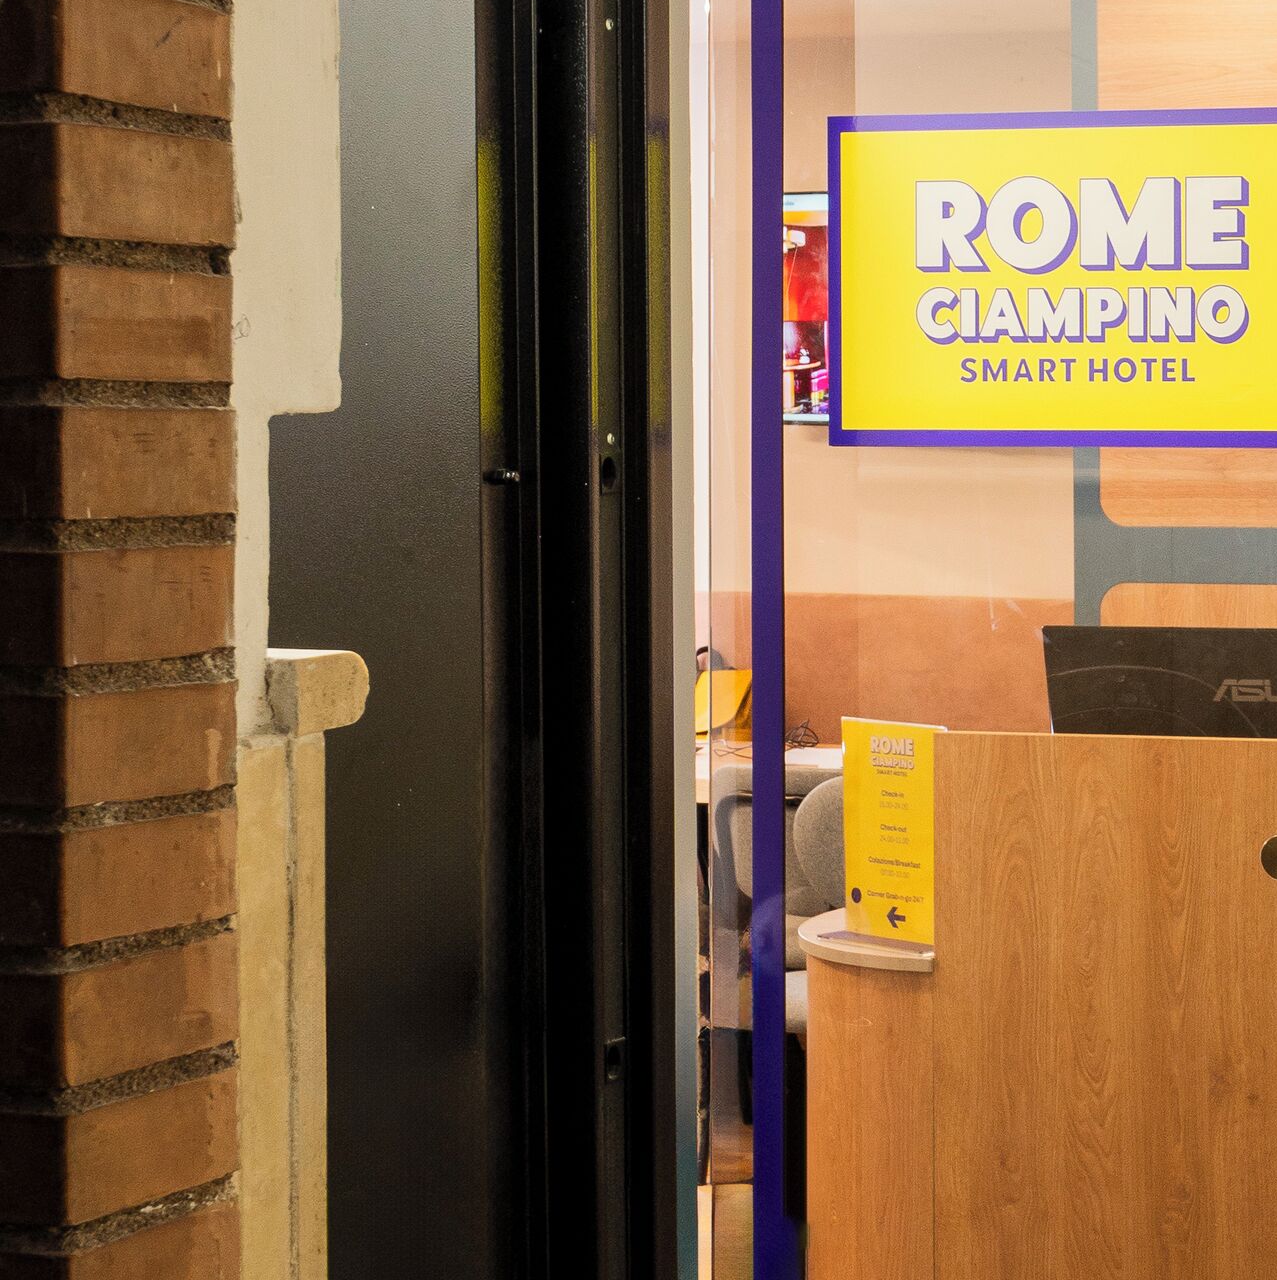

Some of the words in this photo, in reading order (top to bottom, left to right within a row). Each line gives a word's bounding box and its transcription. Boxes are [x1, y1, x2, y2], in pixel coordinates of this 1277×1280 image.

[915, 175, 1250, 275] ROME
[916, 284, 1249, 344] CIAMPINO
[960, 357, 1077, 383] SMART
[1088, 357, 1196, 383] HOTEL
[870, 735, 915, 757] ROME
